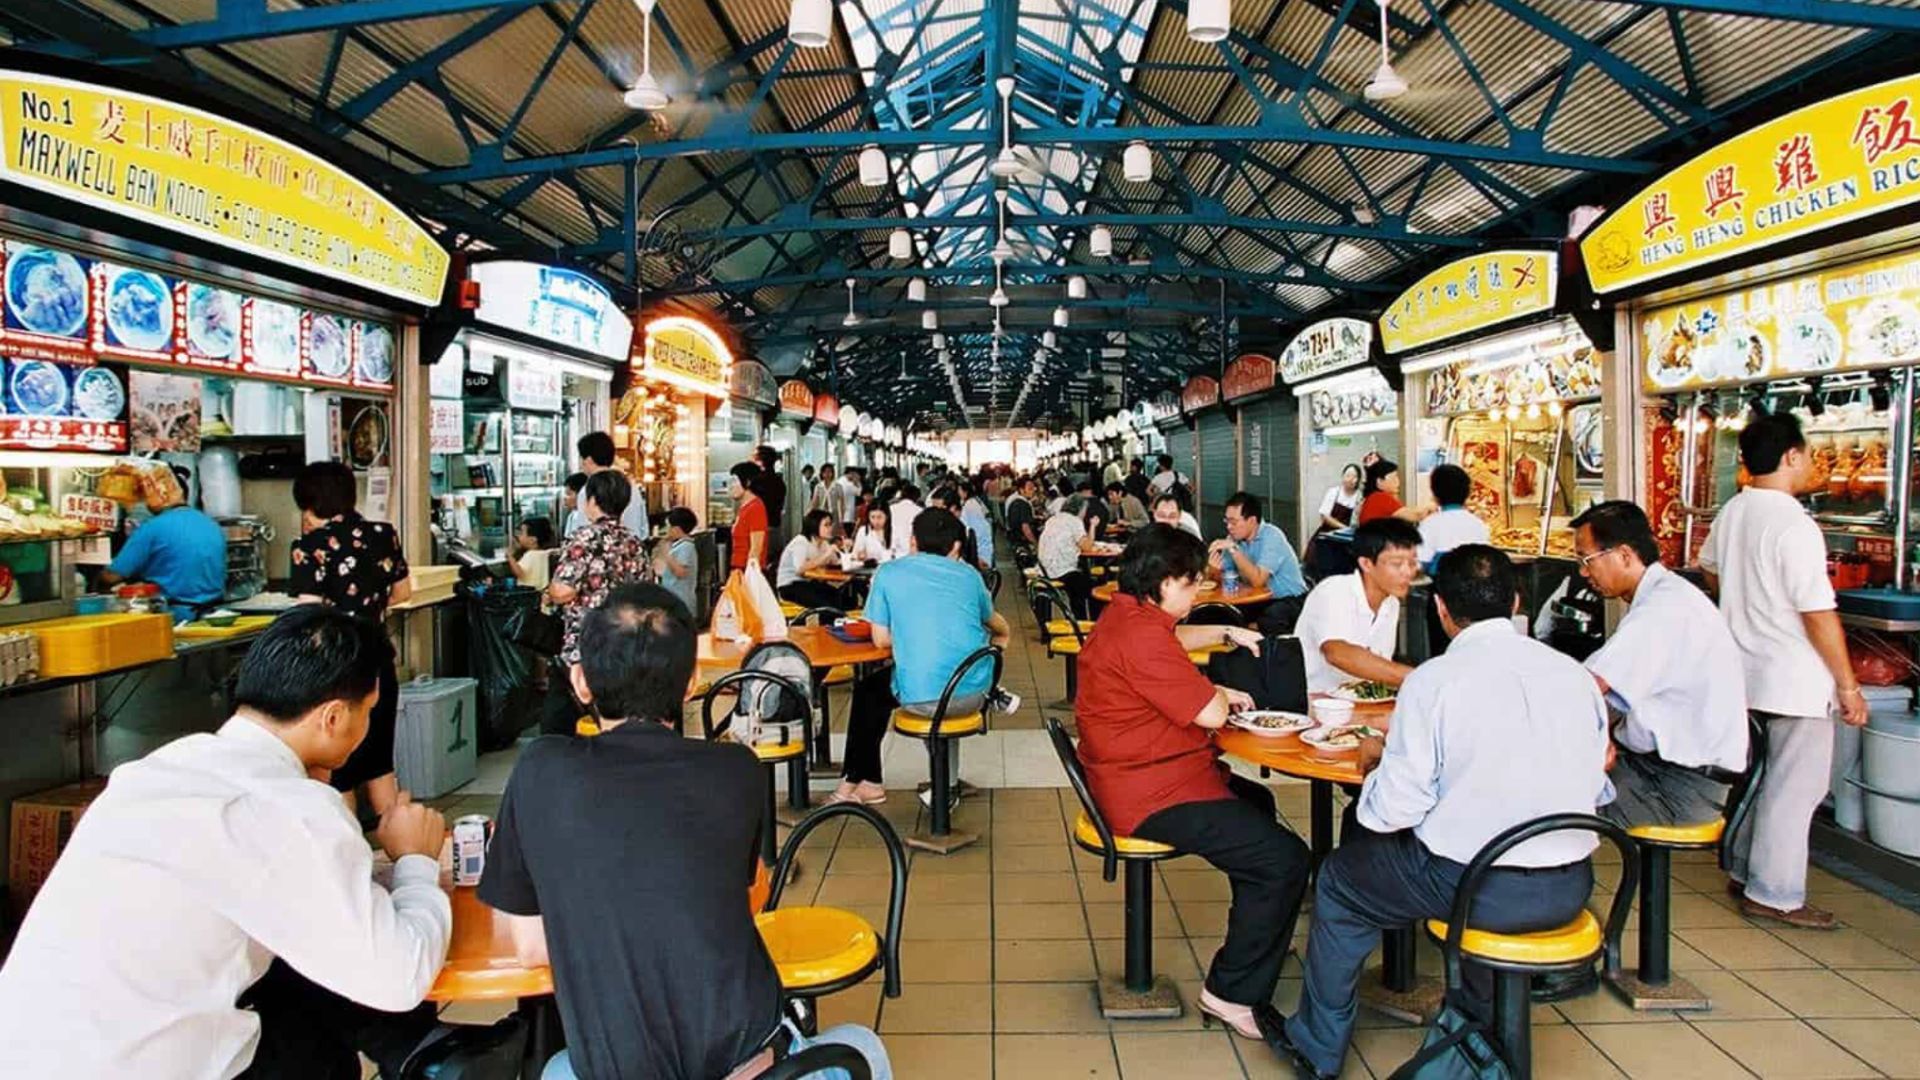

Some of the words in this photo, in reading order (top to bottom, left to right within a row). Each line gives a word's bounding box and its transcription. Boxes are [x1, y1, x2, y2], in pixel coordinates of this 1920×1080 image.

[22, 91, 73, 125] No.1
[19, 126, 117, 196] MAXWELL
[125, 164, 159, 208] BAN
[164, 178, 222, 230] NOODLE
[1642, 240, 1685, 265] HENG
[1694, 219, 1743, 248] HENG
[1755, 179, 1857, 229] CHICKEN
[465, 375, 489, 386] sub
[447, 699, 468, 752] 1
